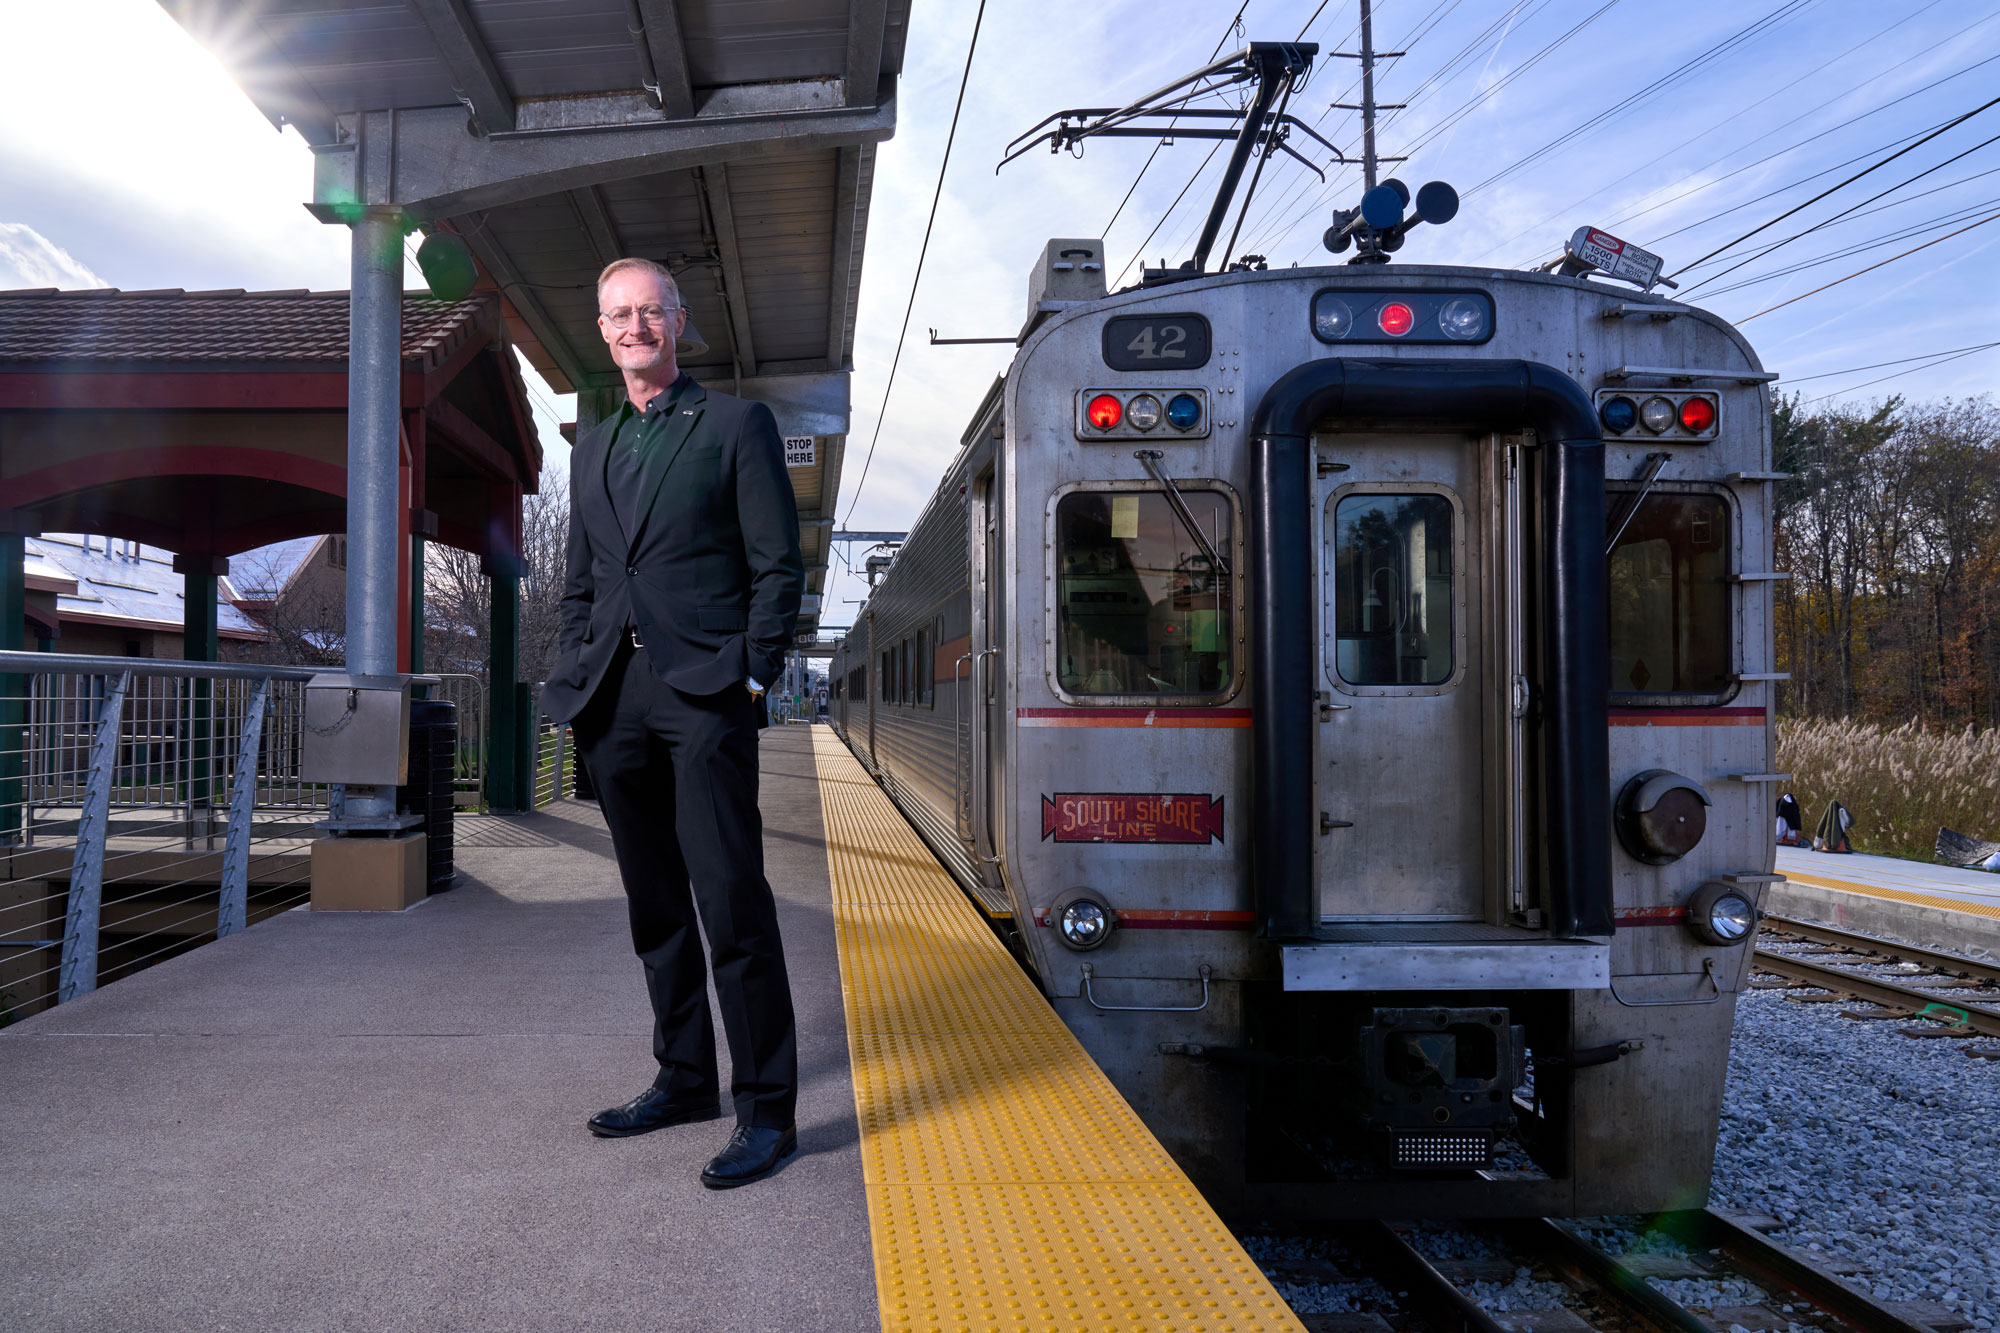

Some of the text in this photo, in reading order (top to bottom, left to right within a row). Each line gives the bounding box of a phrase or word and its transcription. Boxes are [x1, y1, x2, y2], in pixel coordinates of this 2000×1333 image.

[1594, 234, 1617, 248] DANGER
[1585, 251, 1611, 269] VOLTS
[1590, 245, 1613, 261] 1500
[1631, 253, 1649, 264] BOTH
[1622, 254, 1654, 271] PANTOGRAPHS
[1622, 261, 1635, 269] THEN
[1635, 267, 1648, 275] LOCK
[1624, 269, 1642, 279] BOTH
[1127, 325, 1187, 359] 42
[786, 439, 812, 449] STOP
[787, 452, 813, 463] HERE
[1062, 800, 1203, 835] SOUTH SHORE
[1103, 823, 1157, 836] LINE
